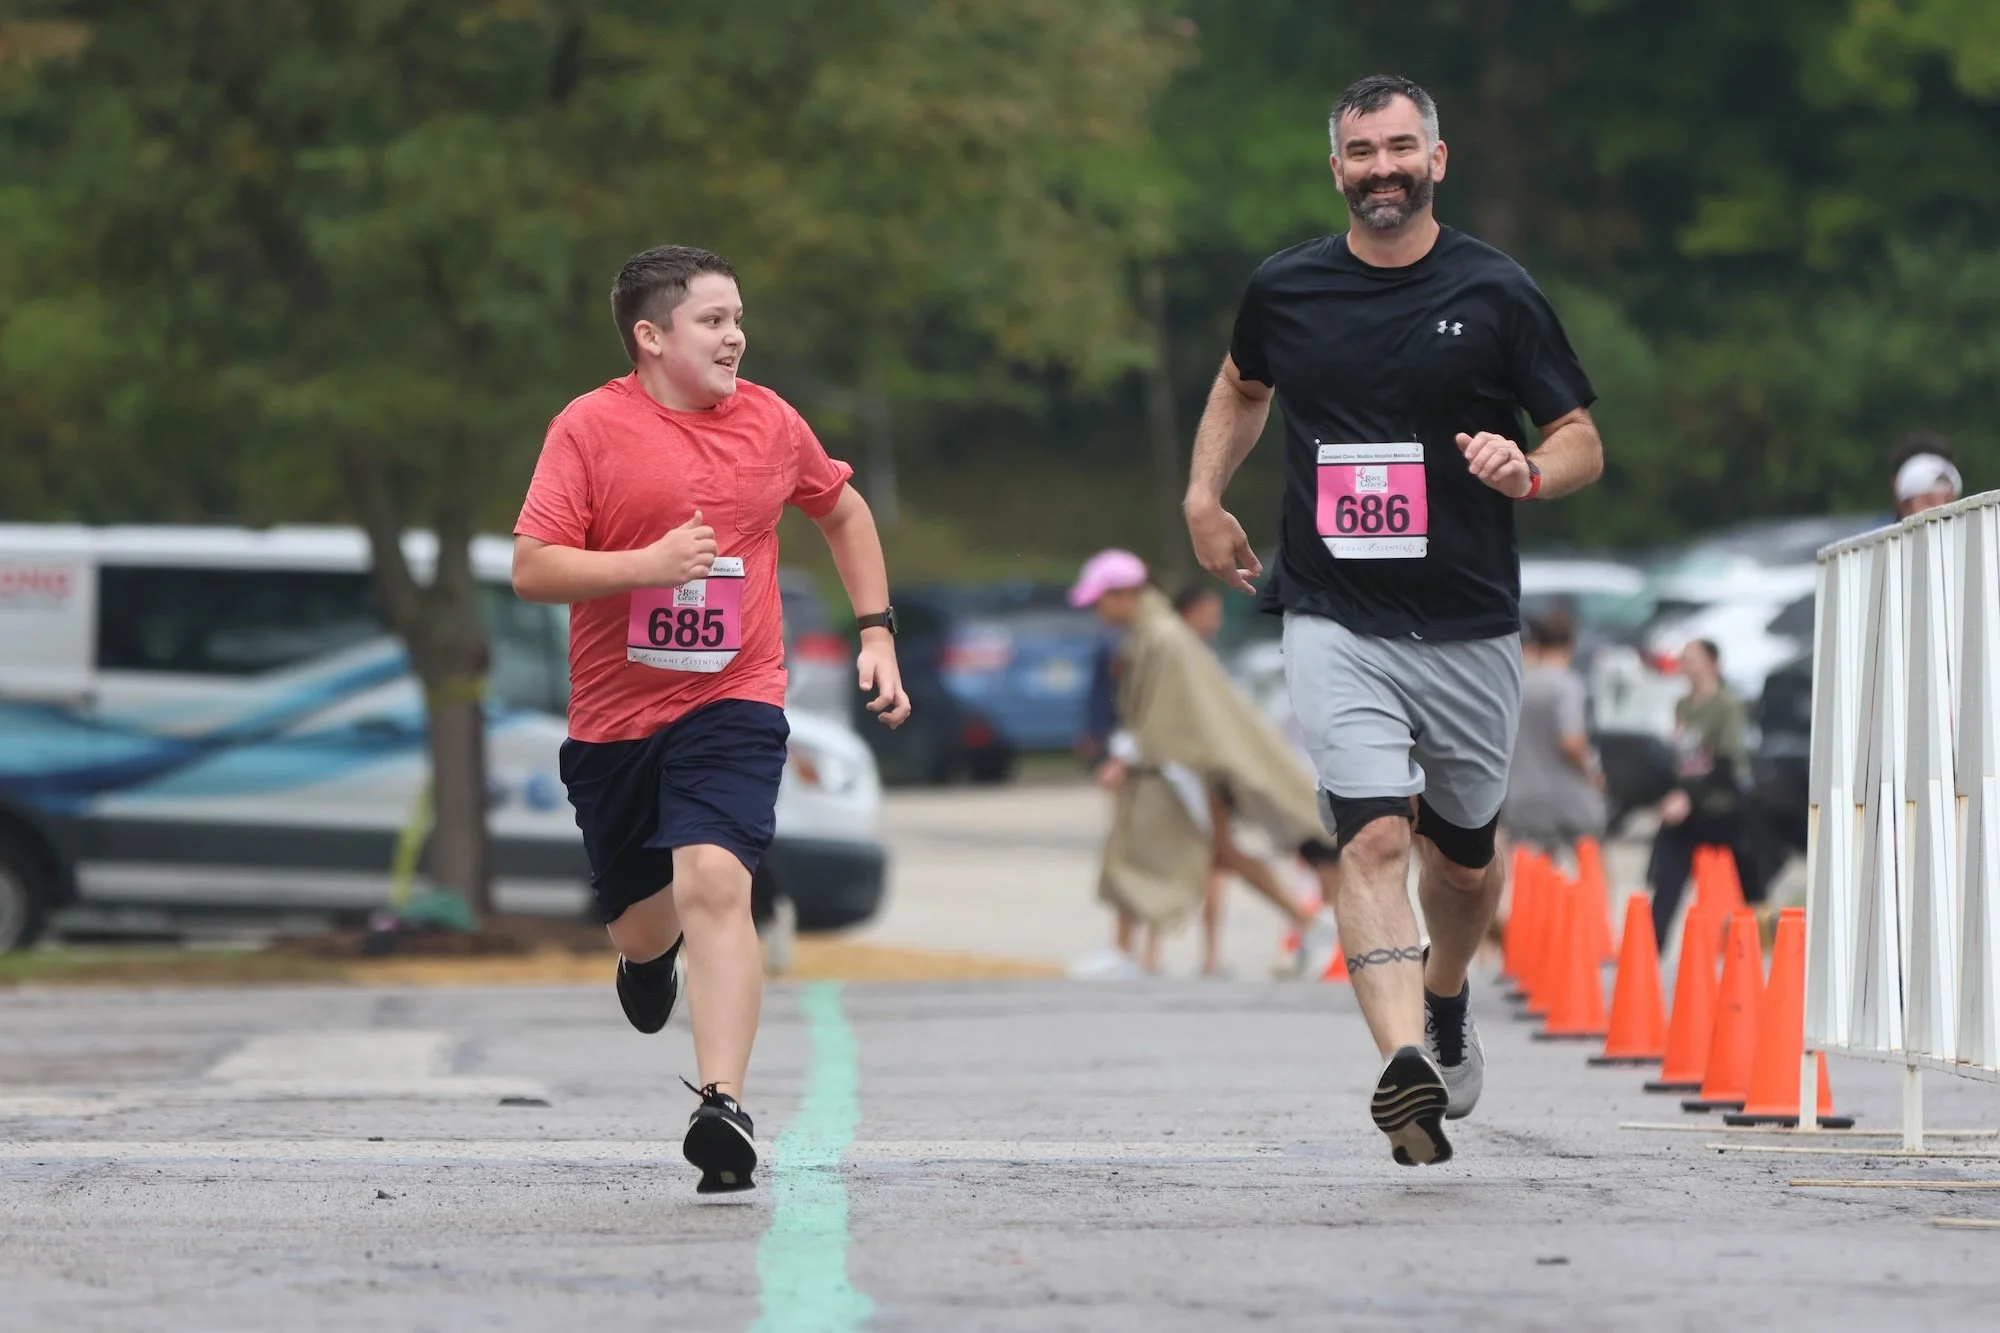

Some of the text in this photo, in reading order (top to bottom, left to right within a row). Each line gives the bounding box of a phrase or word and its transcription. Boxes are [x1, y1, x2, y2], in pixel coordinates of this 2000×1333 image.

[1336, 494, 1410, 533] 686
[682, 588, 699, 597] Race
[648, 608, 724, 647] 685
